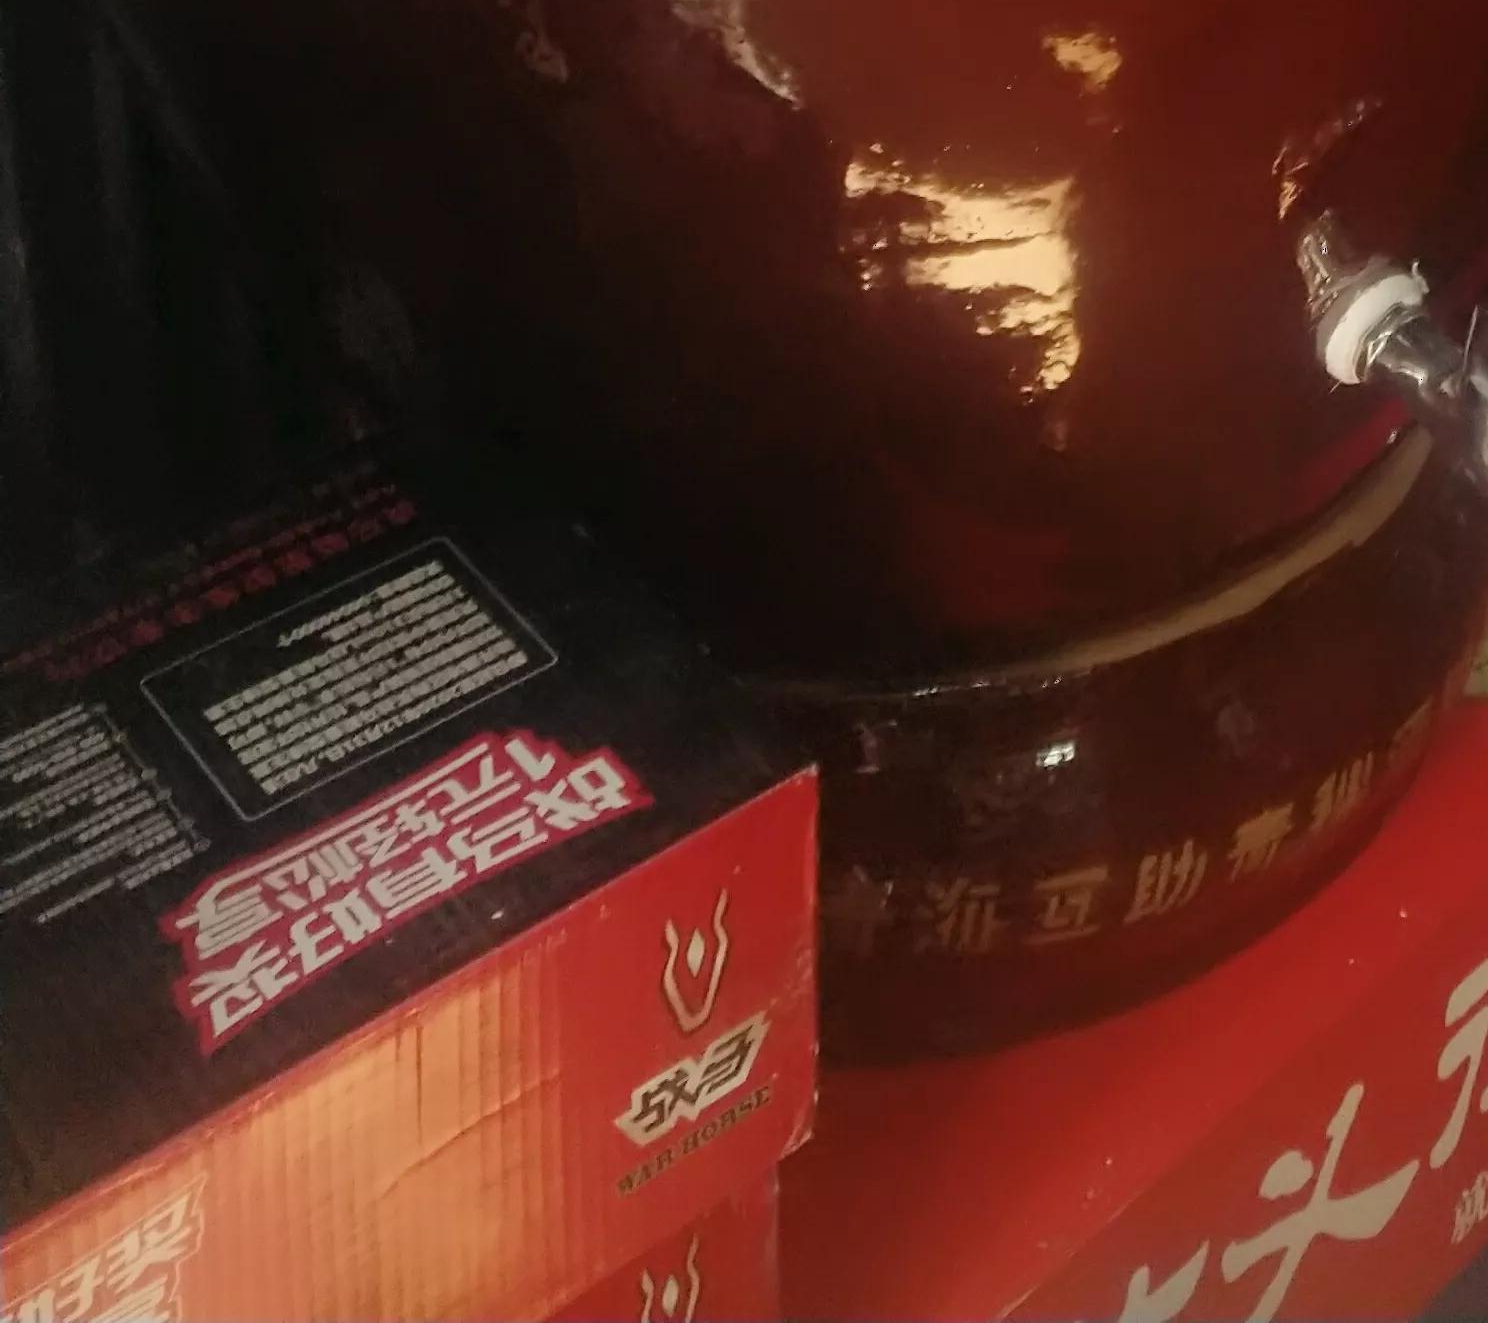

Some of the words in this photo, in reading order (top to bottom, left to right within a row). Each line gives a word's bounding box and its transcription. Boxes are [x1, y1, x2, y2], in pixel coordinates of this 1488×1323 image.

[190, 753, 633, 1041] 战马有好奖
